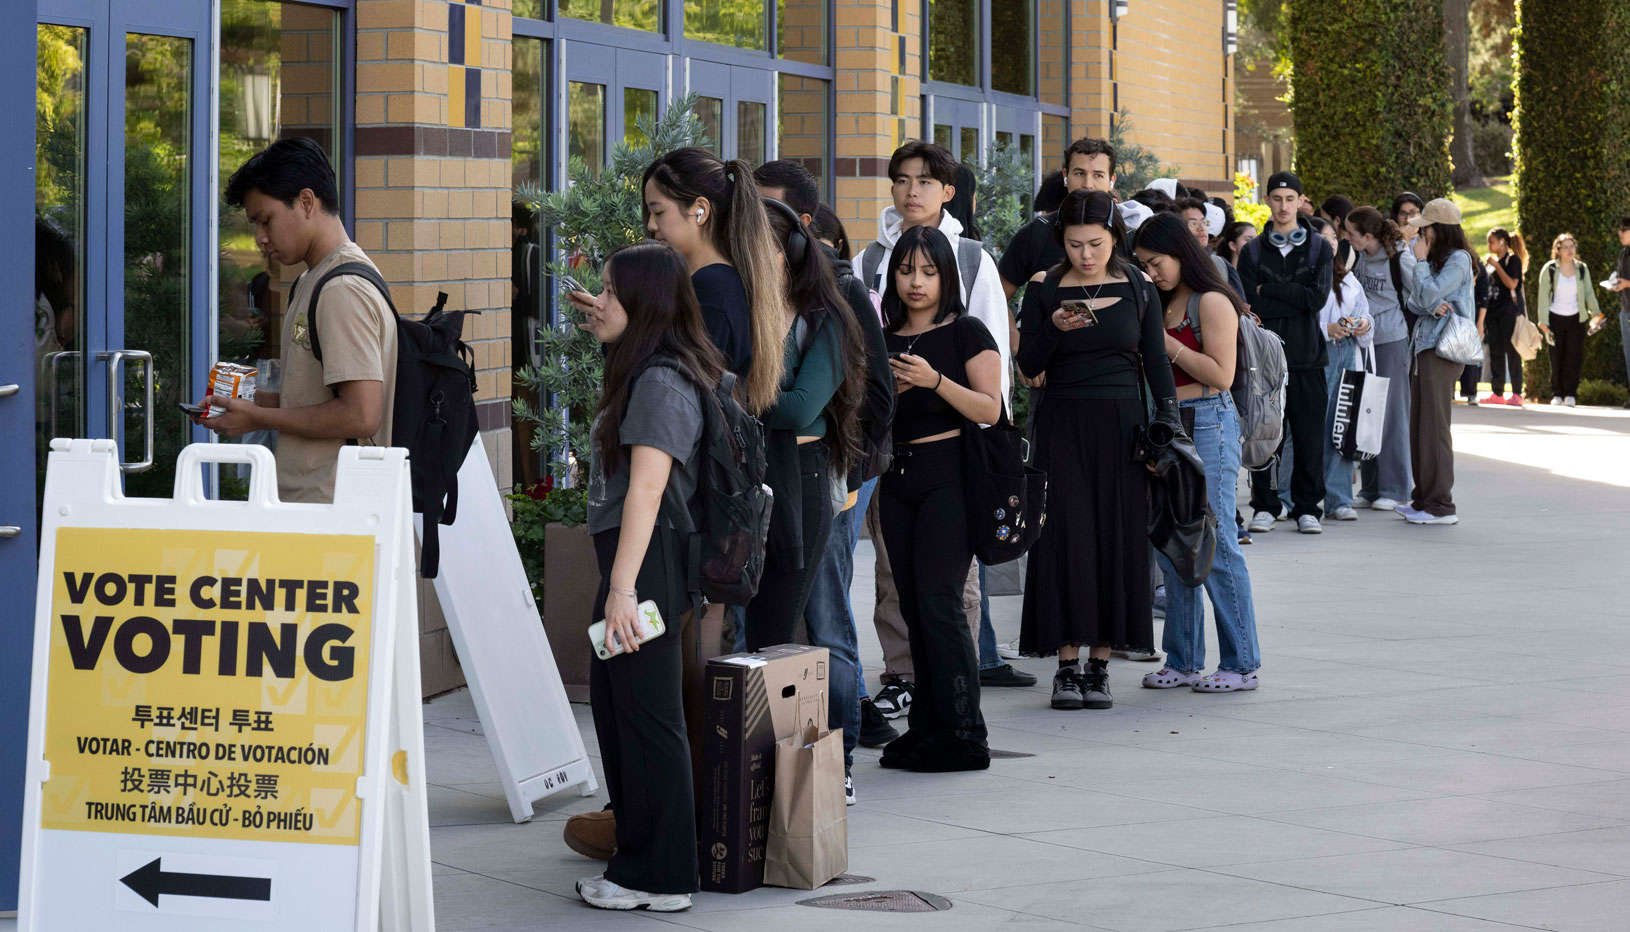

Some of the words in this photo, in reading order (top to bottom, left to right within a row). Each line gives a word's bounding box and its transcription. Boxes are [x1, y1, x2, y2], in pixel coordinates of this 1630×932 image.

[63, 571, 177, 608] VOTE
[189, 575, 361, 614] CENTER
[60, 614, 356, 682] VOTING
[131, 704, 220, 732] 투표센터
[228, 708, 274, 734] 투표
[77, 736, 132, 756] VOTAR
[144, 739, 211, 760] CENTRO
[214, 742, 237, 761] DE
[240, 742, 330, 766] VOTACIÓN
[120, 766, 280, 800] 投票中心投票
[85, 801, 137, 822] TRUNG
[139, 801, 173, 824] TÂM
[175, 802, 208, 826] BẦU
[209, 803, 232, 827] CỬ
[241, 804, 264, 829] BỎ
[266, 807, 314, 832] PHIẾU
